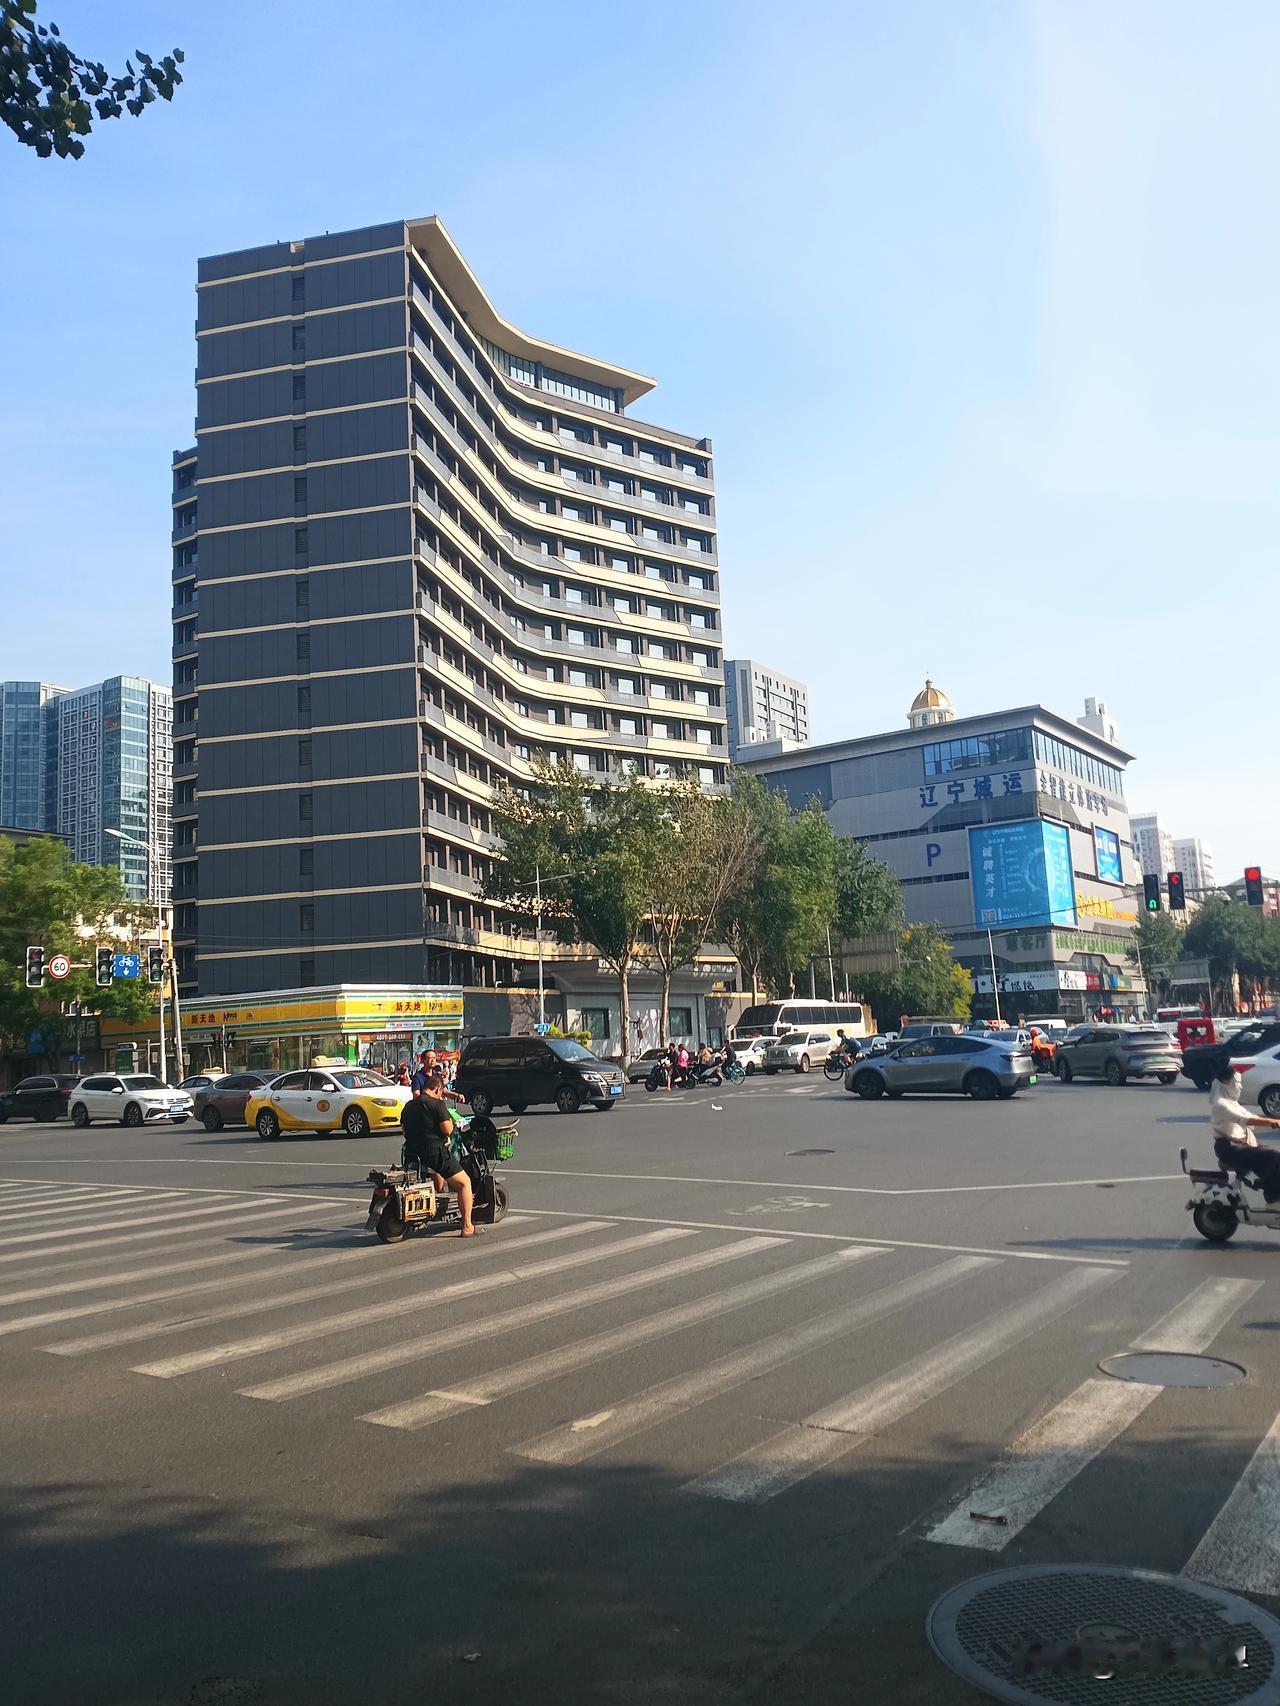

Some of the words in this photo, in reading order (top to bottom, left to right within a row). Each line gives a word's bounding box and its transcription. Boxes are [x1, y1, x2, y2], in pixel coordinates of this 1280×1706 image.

[920, 771, 1023, 808] 辽宁城运
[926, 843, 942, 868] P
[982, 847, 996, 898] 诚聘英才
[54, 962, 66, 972] 60
[395, 1001, 421, 1011] 新天地
[191, 1013, 215, 1024] 新天地
